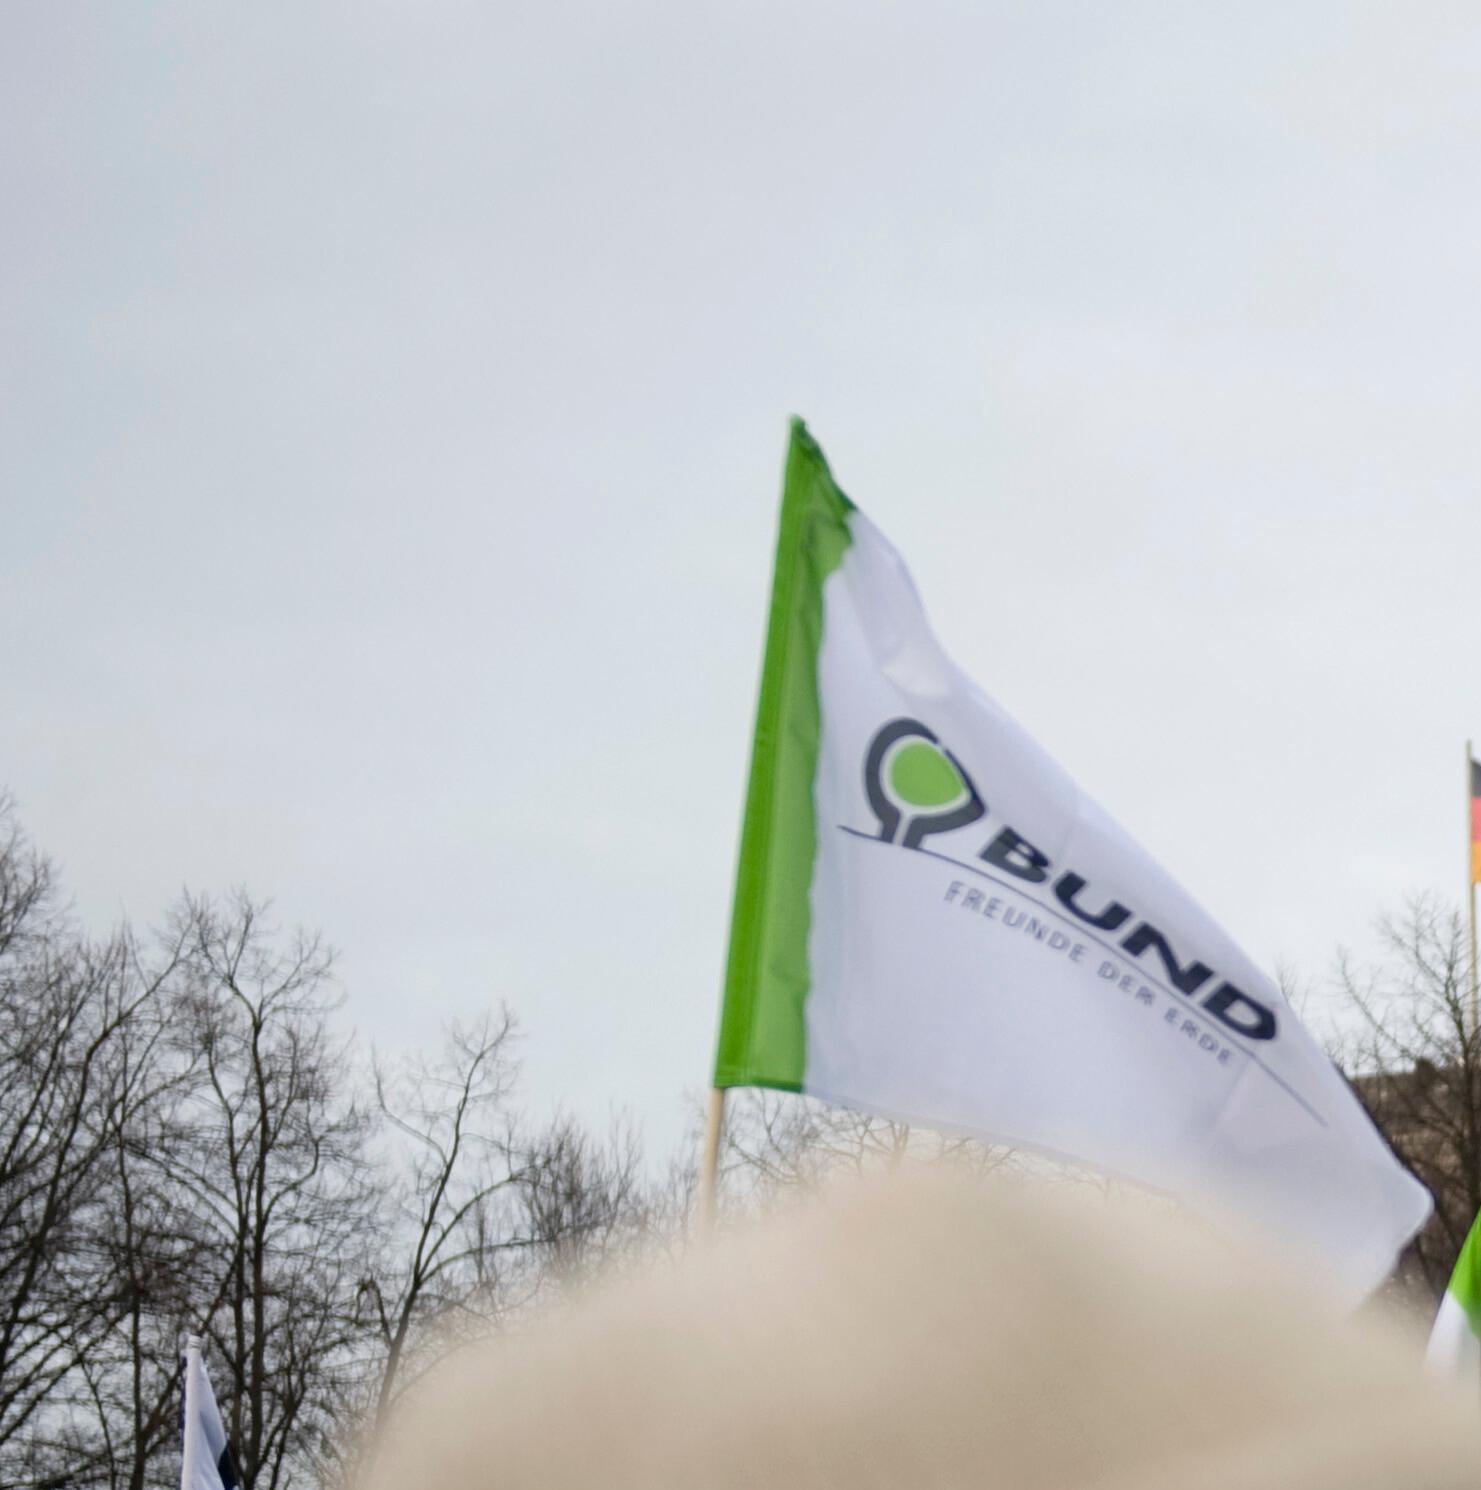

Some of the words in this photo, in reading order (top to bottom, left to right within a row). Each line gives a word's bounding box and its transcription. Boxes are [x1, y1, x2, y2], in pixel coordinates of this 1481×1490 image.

[944, 880, 1088, 964] FREUNDE
[1097, 960, 1156, 1007] DER
[1163, 1006, 1236, 1066] ERDE
[978, 826, 1276, 1041] BUND
